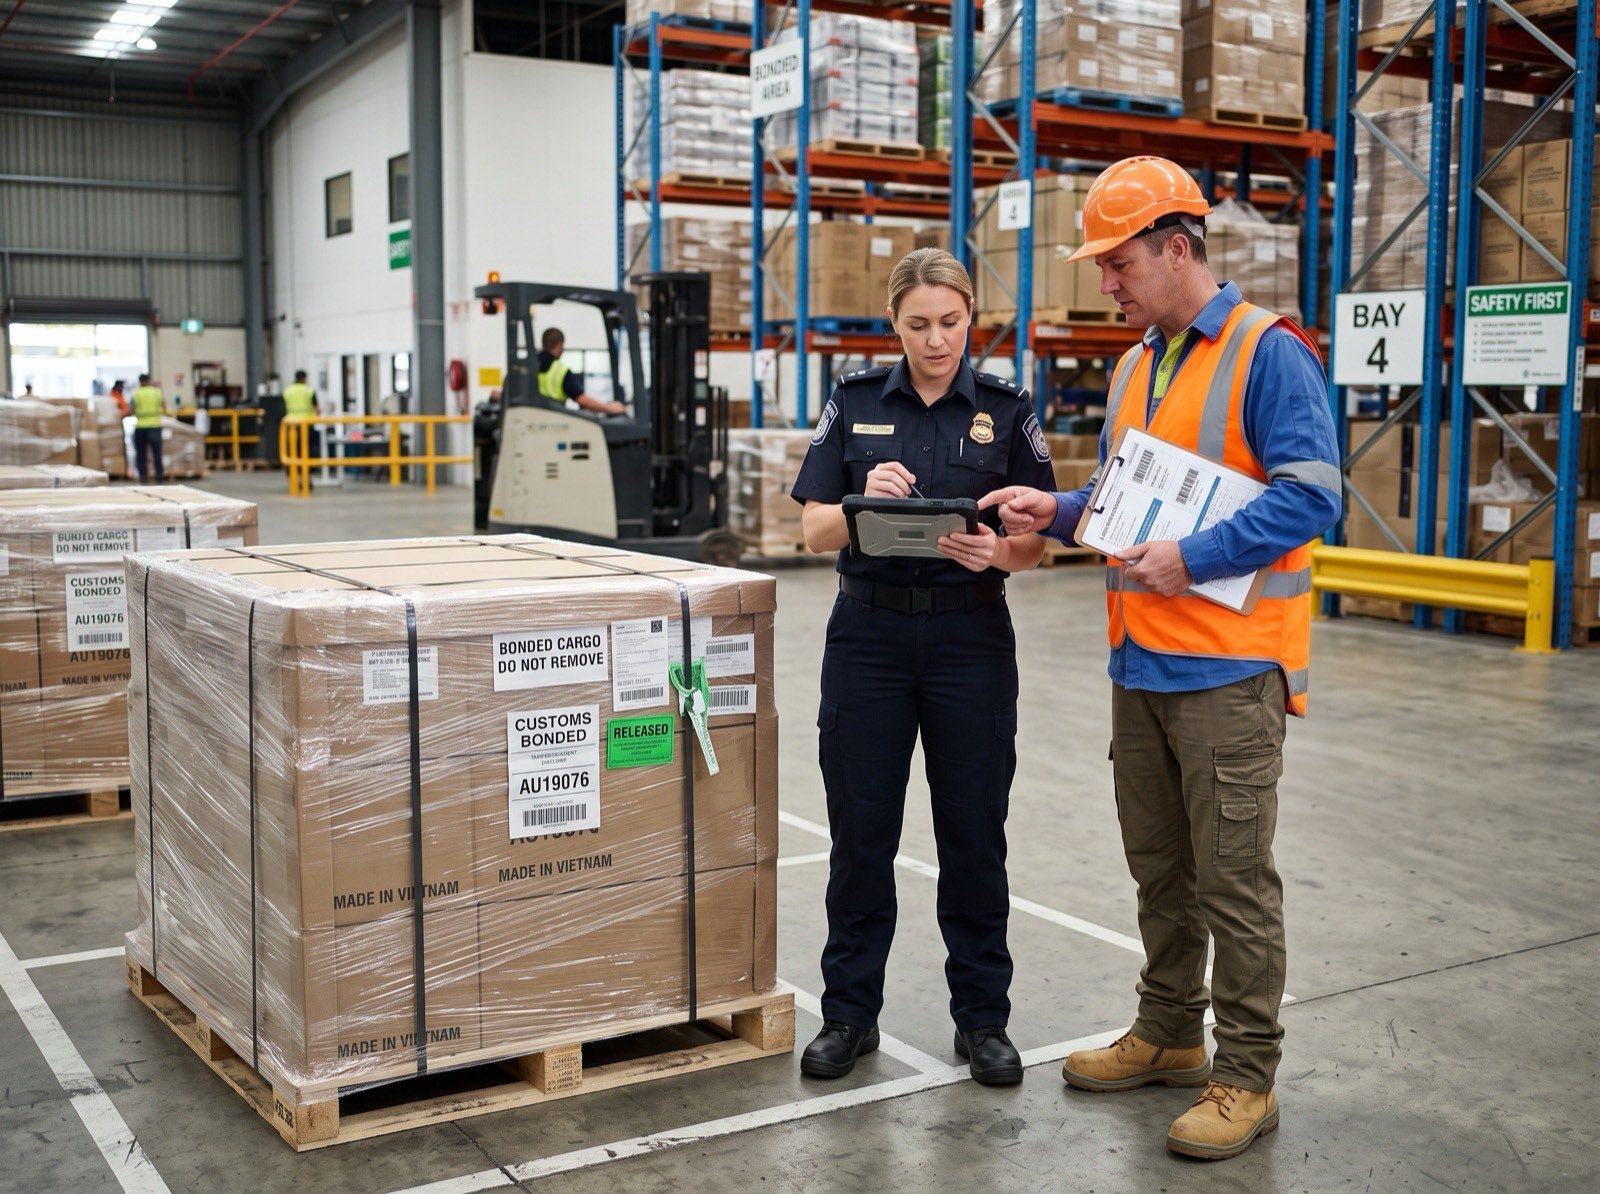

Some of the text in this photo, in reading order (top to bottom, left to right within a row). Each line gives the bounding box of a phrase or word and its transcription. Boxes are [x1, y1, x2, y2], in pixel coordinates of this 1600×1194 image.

[1471, 291, 1564, 313] SAFETY FIRST
[1353, 303, 1406, 328] BAY
[1366, 337, 1389, 374] 4
[56, 542, 130, 554] DO NOT REMOVE
[70, 576, 125, 587] CUSTOMS
[74, 587, 121, 597] BONDED
[75, 613, 124, 625] AU19076
[499, 634, 601, 655] BONDED CARGO
[498, 652, 604, 674] DO NOT REMOVE
[0, 682, 27, 692] TNAM
[62, 672, 131, 685] MADE IN VIETN
[515, 712, 592, 731] CUSTOMS
[613, 723, 669, 739] RELEASED
[521, 729, 587, 748] BONDED
[519, 771, 590, 795] AU19076
[498, 853, 613, 882] MADE IN VIETNAM
[333, 891, 375, 910] MADE
[379, 889, 393, 904] IN
[337, 1039, 378, 1059] MADE
[382, 1036, 396, 1051] IN
